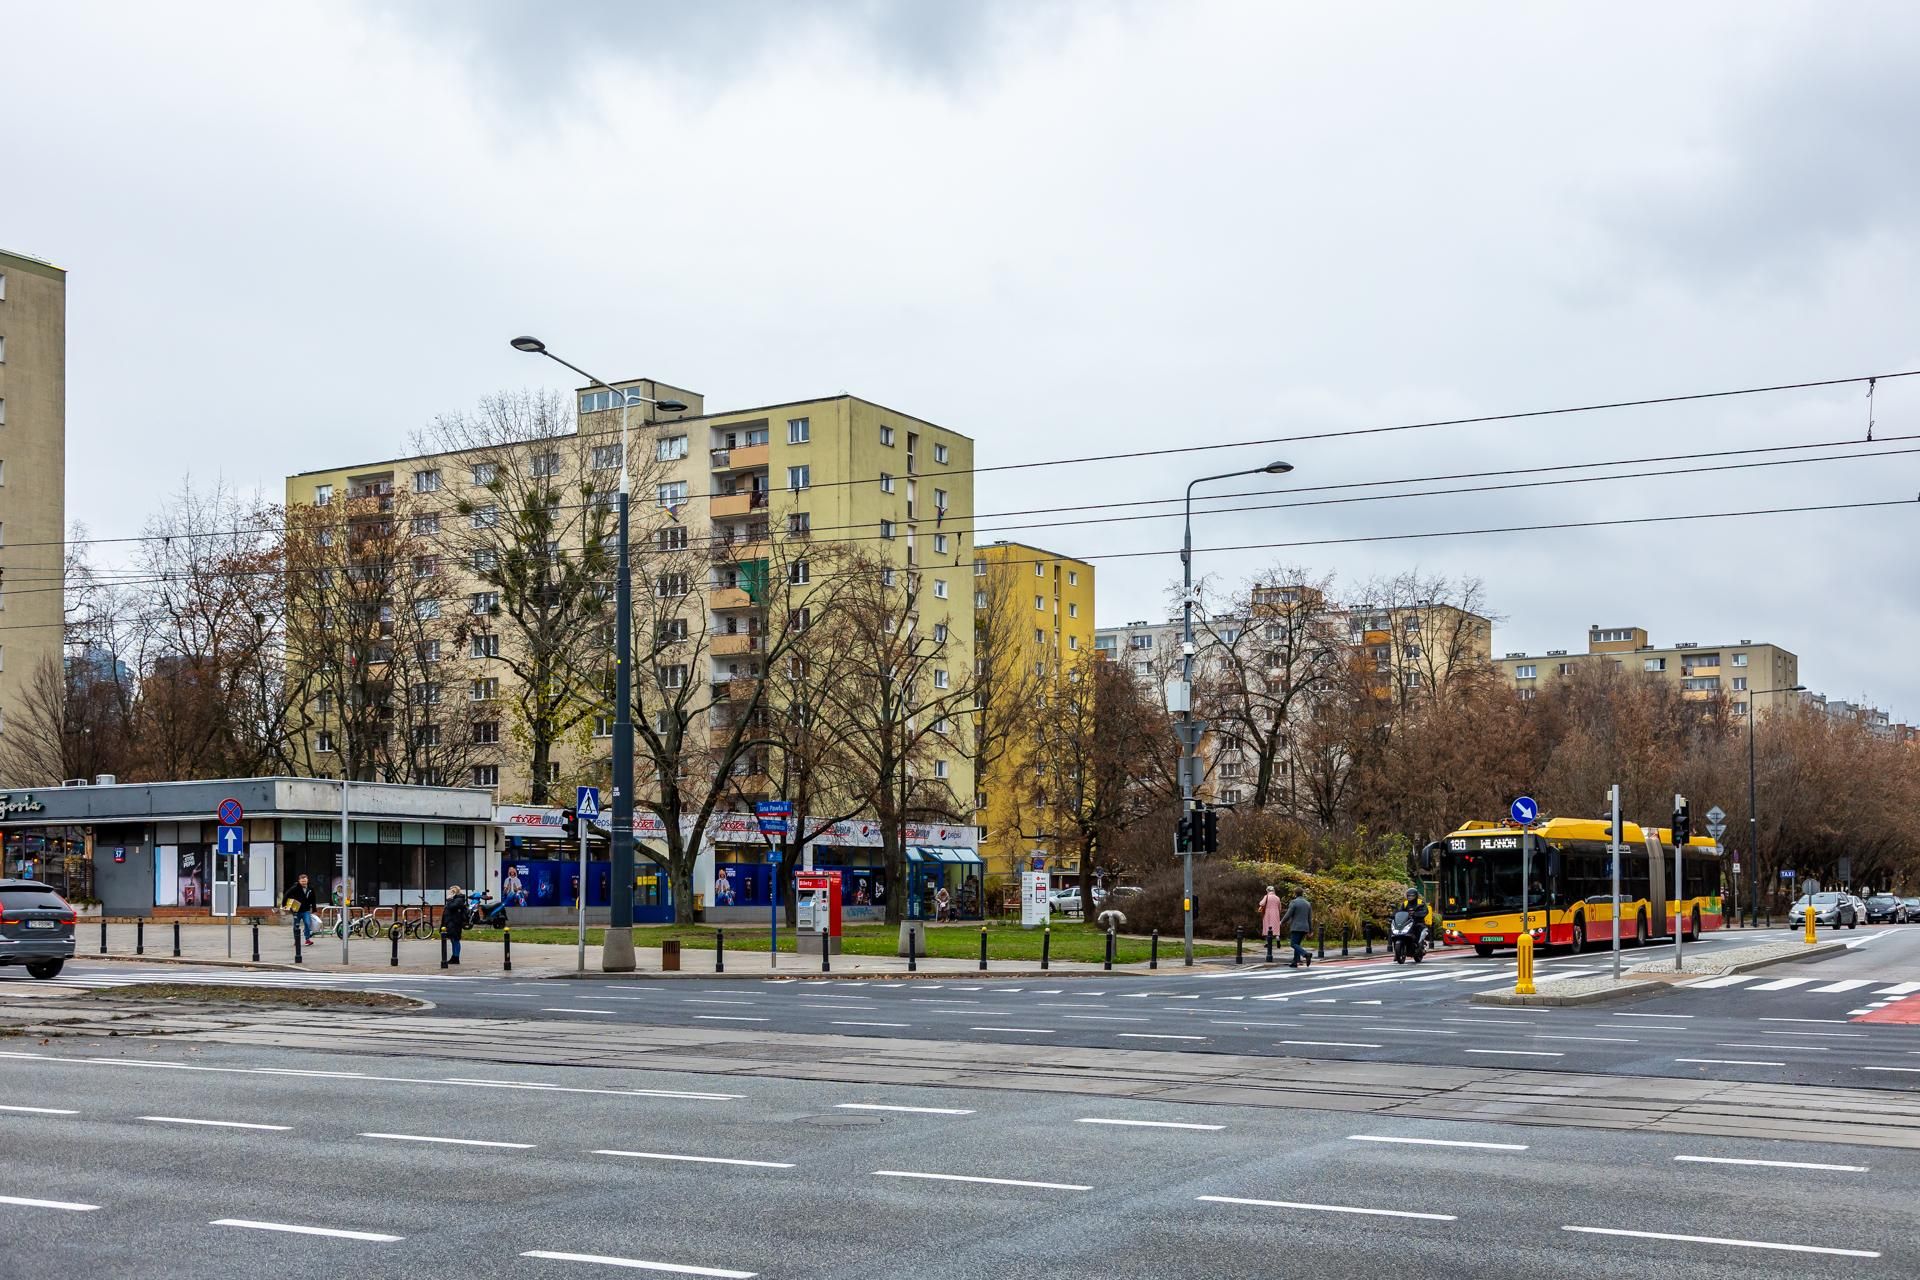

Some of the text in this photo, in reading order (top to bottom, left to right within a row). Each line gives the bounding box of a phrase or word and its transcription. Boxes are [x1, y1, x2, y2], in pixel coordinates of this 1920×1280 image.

[947, 831, 961, 839] pepsi
[1450, 837, 1517, 851] 180 WILANÓW
[1519, 915, 1536, 923] 563
